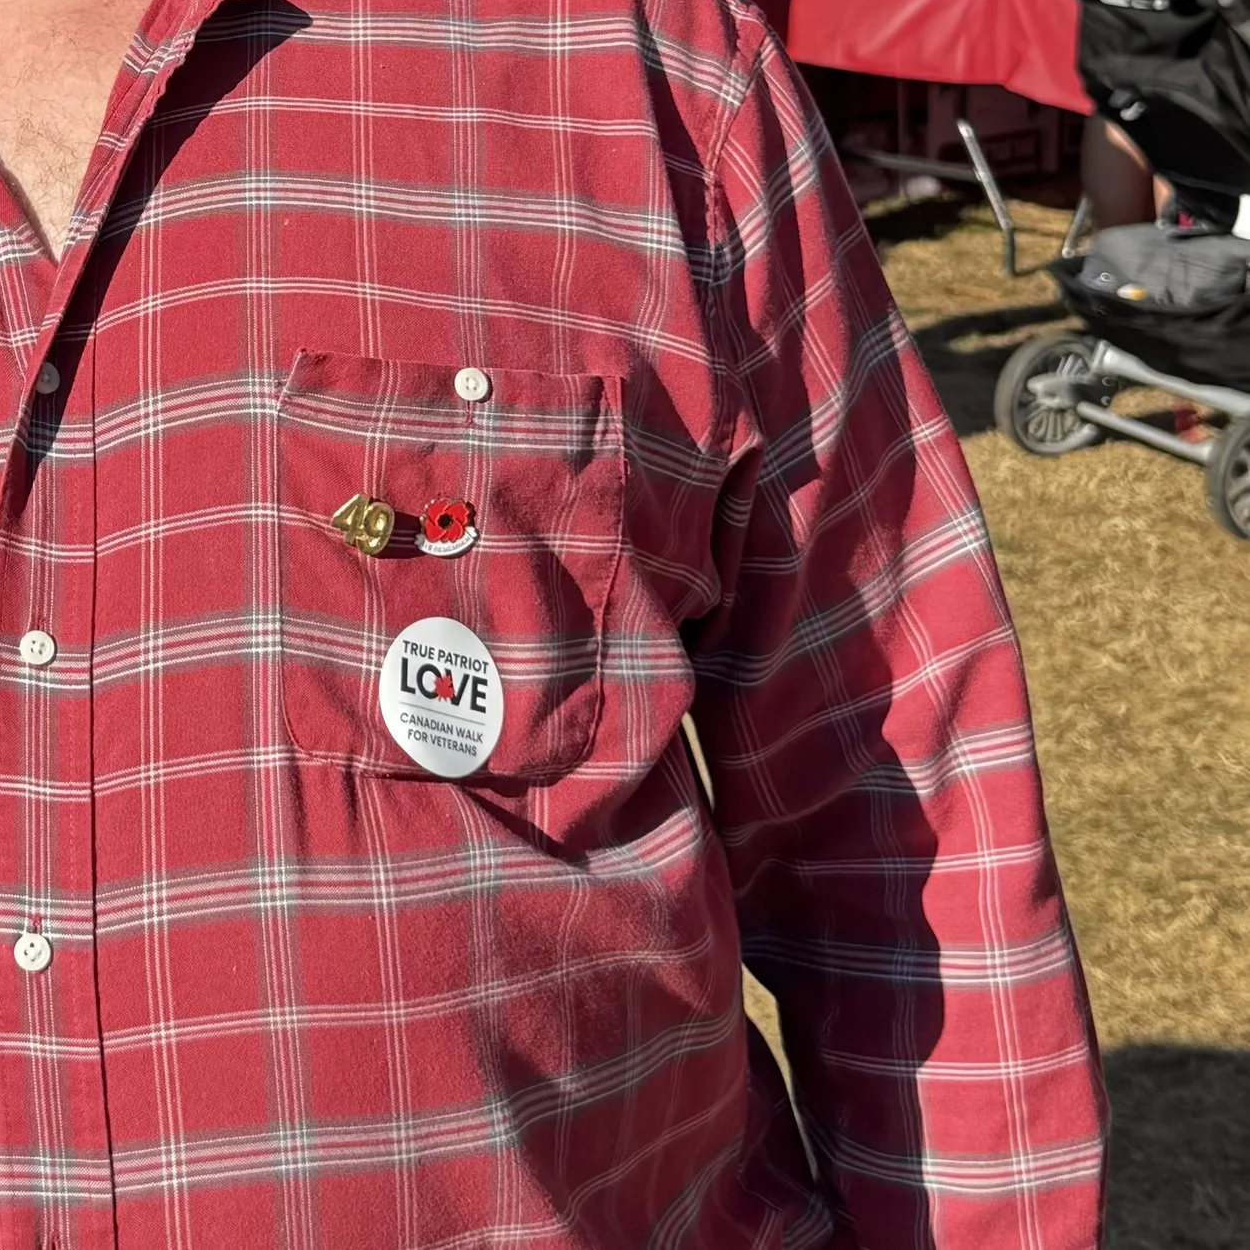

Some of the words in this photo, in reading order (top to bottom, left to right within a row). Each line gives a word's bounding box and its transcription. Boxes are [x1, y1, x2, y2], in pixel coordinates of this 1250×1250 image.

[331, 493, 395, 555] 49
[402, 640, 435, 660] TRUE
[438, 649, 489, 675] PATRIOT
[400, 657, 488, 714] LOVE
[400, 712, 454, 735] CANADIAN
[455, 728, 484, 744] WALK
[408, 728, 429, 743] FOR
[430, 735, 478, 757] VETERANS
